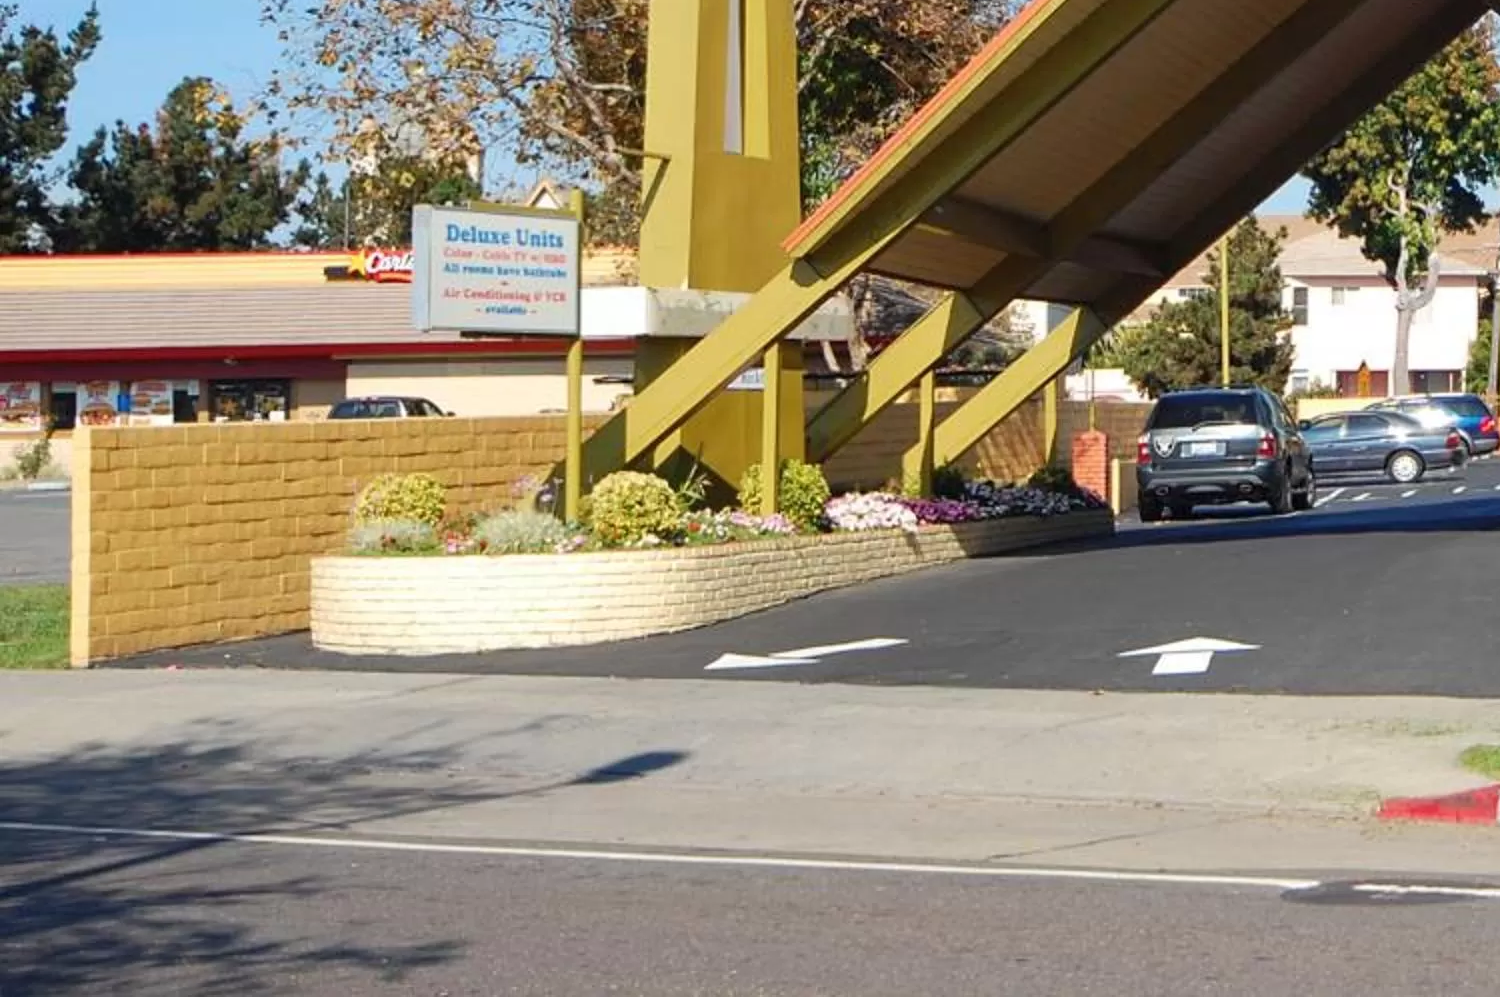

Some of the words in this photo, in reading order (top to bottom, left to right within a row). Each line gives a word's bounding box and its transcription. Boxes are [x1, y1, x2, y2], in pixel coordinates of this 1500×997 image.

[446, 223, 512, 245] Deluxe
[515, 228, 565, 249] Units
[443, 262, 460, 274] All
[462, 265, 495, 276] rooms
[497, 265, 521, 277] have
[443, 286, 460, 299] Air
[463, 288, 531, 303] Conditioning
